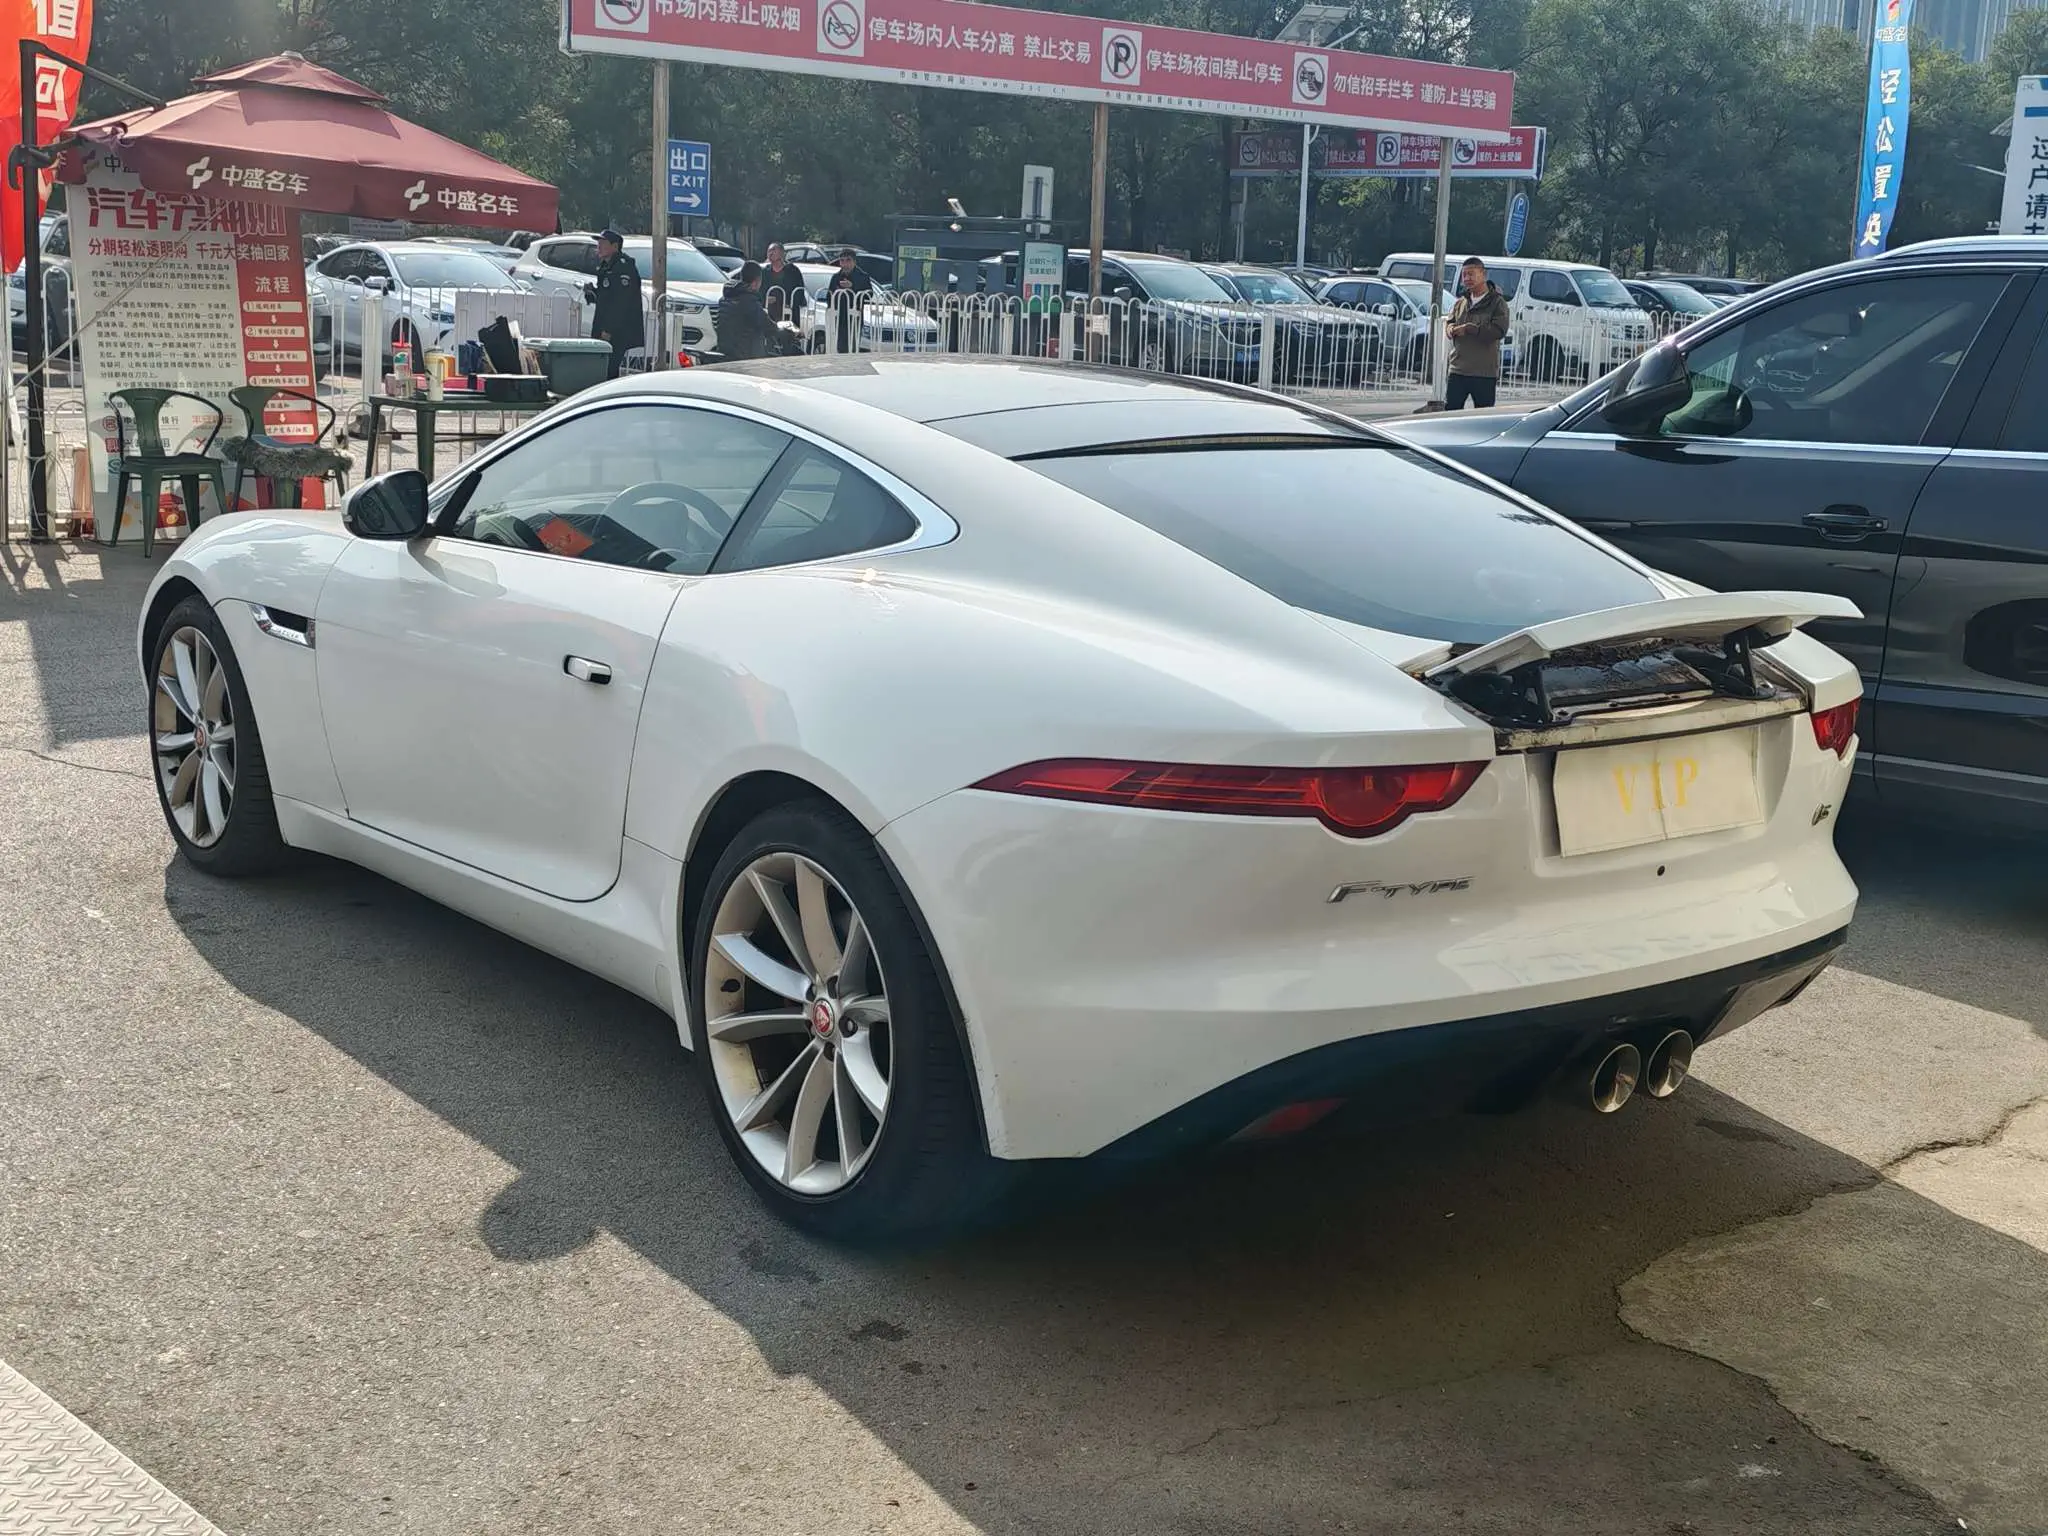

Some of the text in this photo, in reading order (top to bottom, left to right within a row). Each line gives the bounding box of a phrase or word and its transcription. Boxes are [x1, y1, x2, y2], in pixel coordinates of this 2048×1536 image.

[654, 0, 801, 31] 市场内禁止吸烟
[868, 16, 1091, 65] 停车场内人车分离 禁止交易
[1145, 49, 1283, 86] 停车场夜间禁止停车
[1332, 72, 1497, 111] 勿信招手拦车 谨防上当受骗
[670, 148, 707, 171] 出口
[221, 164, 310, 195] 中盛名车
[671, 174, 706, 188] EXIT
[436, 187, 519, 216] 中盛名车
[88, 238, 189, 259] 分期轻松透明购
[255, 276, 290, 294] 流程
[1611, 757, 1699, 816] VIP
